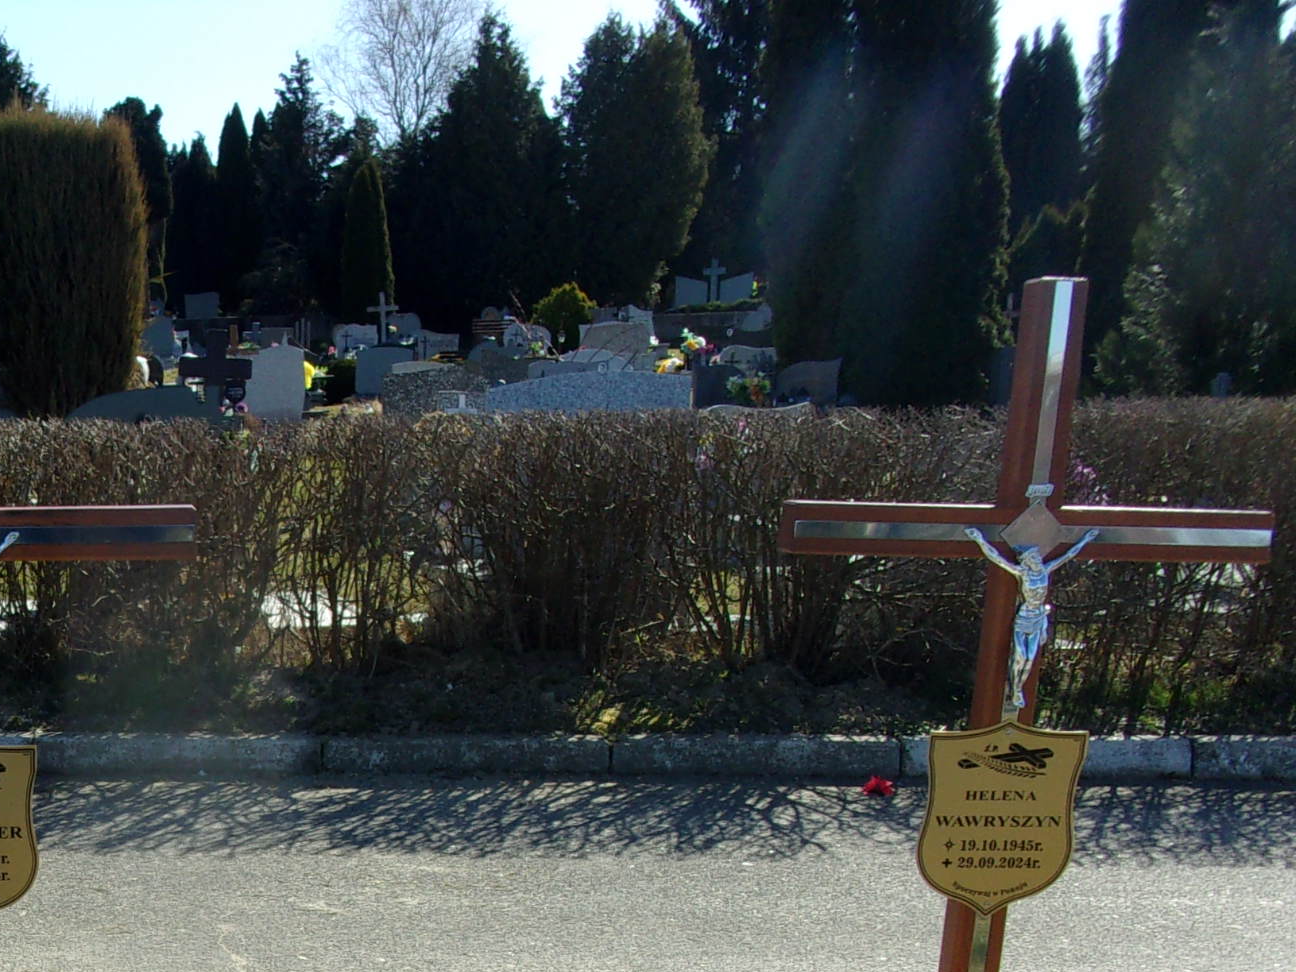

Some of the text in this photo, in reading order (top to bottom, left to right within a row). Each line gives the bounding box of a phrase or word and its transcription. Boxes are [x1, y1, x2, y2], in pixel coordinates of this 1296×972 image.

[965, 790, 1037, 801] HELENA
[935, 815, 1061, 828] WAWRYSZYN
[959, 839, 1043, 852] 19.10.1945r.
[957, 857, 1041, 869] 29.09.2024r.
